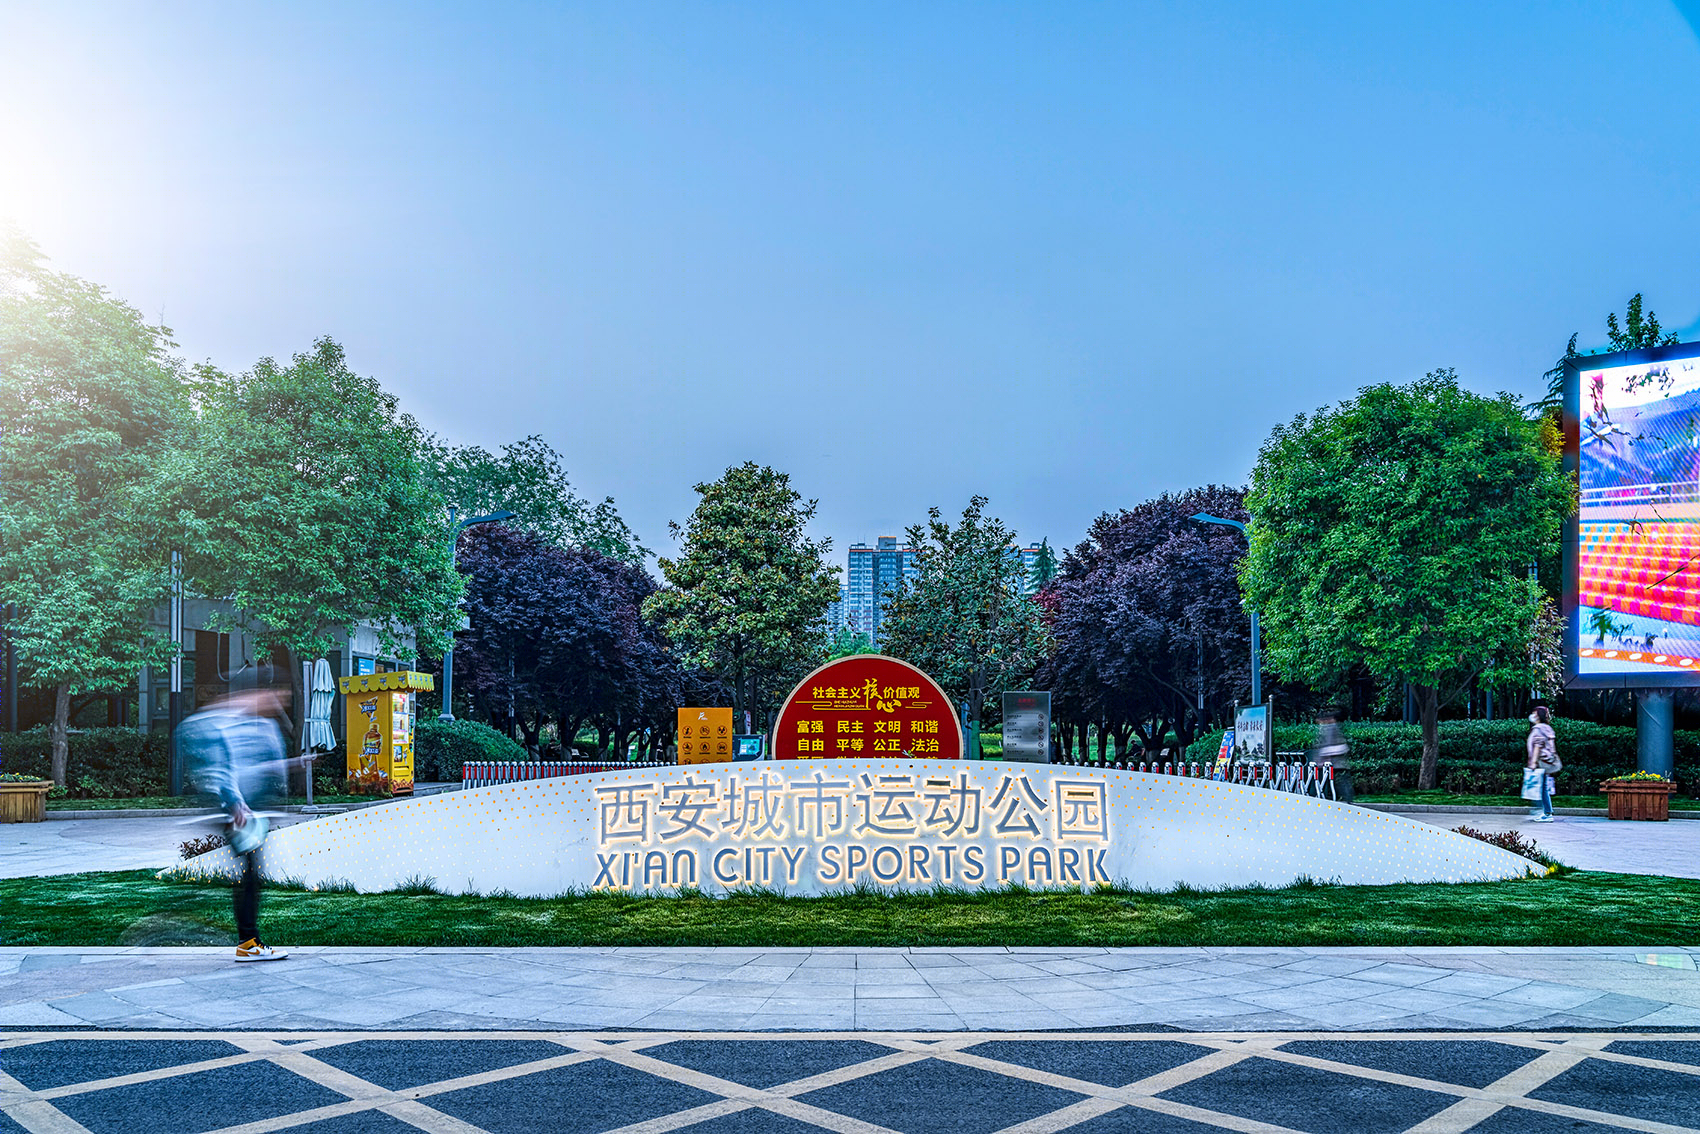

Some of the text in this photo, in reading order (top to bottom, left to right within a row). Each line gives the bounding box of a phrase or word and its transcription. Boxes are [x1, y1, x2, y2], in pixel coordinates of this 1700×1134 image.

[812, 686, 861, 699] 社会主义
[883, 686, 920, 699] 价值观
[796, 720, 939, 734] 富强 民主 文明 和谐
[797, 738, 940, 753] 自由 平等 公正 法治
[595, 772, 1109, 844] 西安城市运动公园
[592, 845, 1111, 888] XI'AN CITY SPORTS PARK
